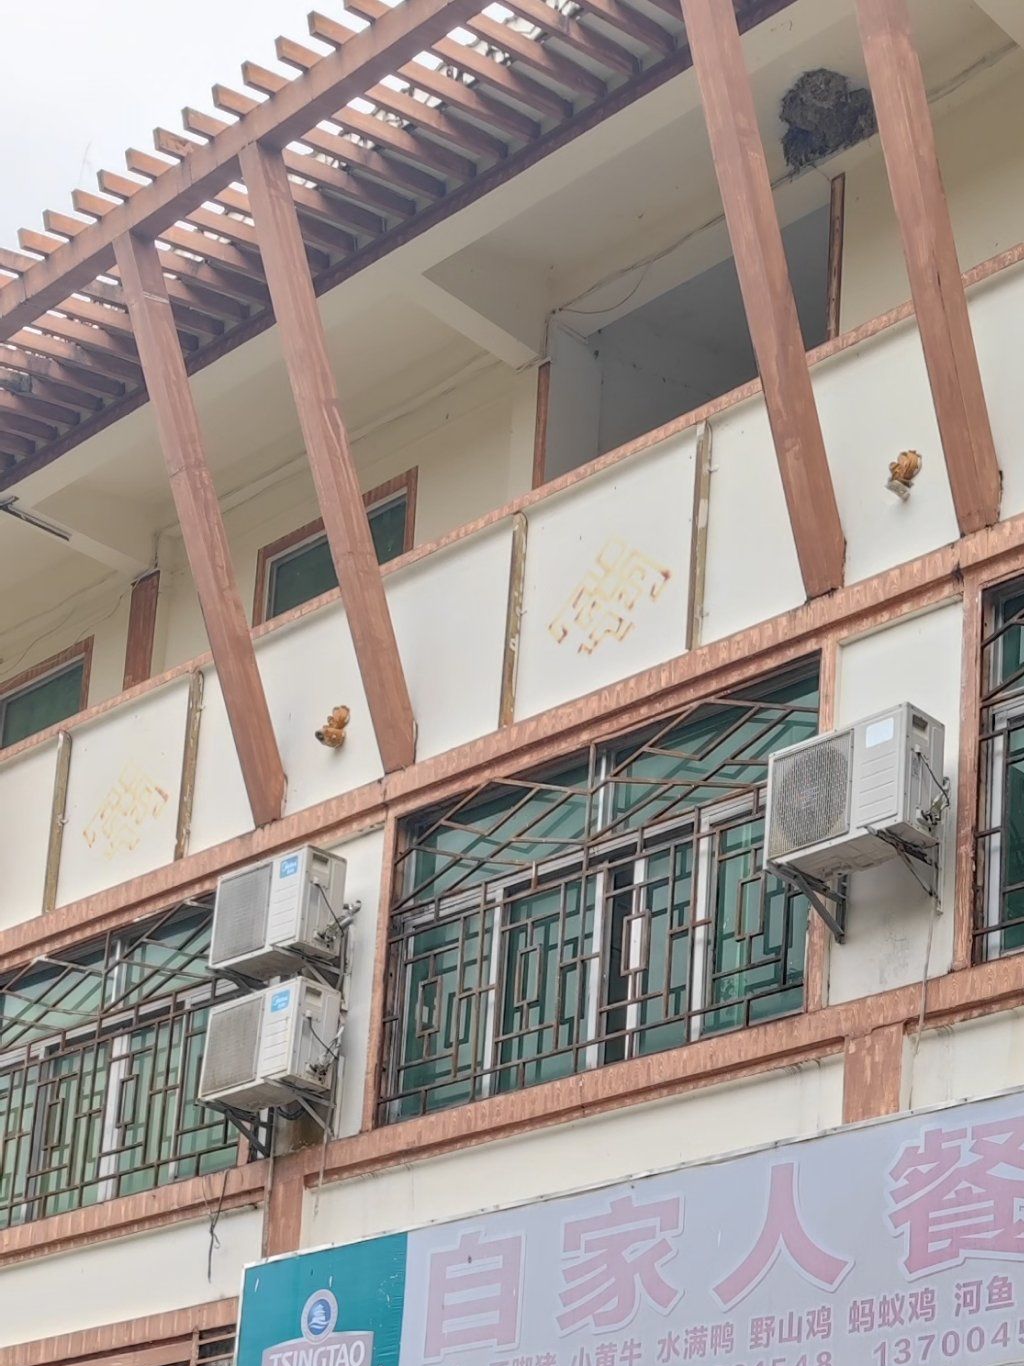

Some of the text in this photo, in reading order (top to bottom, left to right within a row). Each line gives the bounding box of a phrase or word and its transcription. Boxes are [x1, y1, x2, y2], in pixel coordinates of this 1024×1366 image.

[656, 1328, 735, 1366] 水满鸭
[748, 1304, 833, 1351] 野山鸡
[848, 1287, 936, 1334] 蚂蚁鸡
[954, 1274, 1016, 1318] 河鱼
